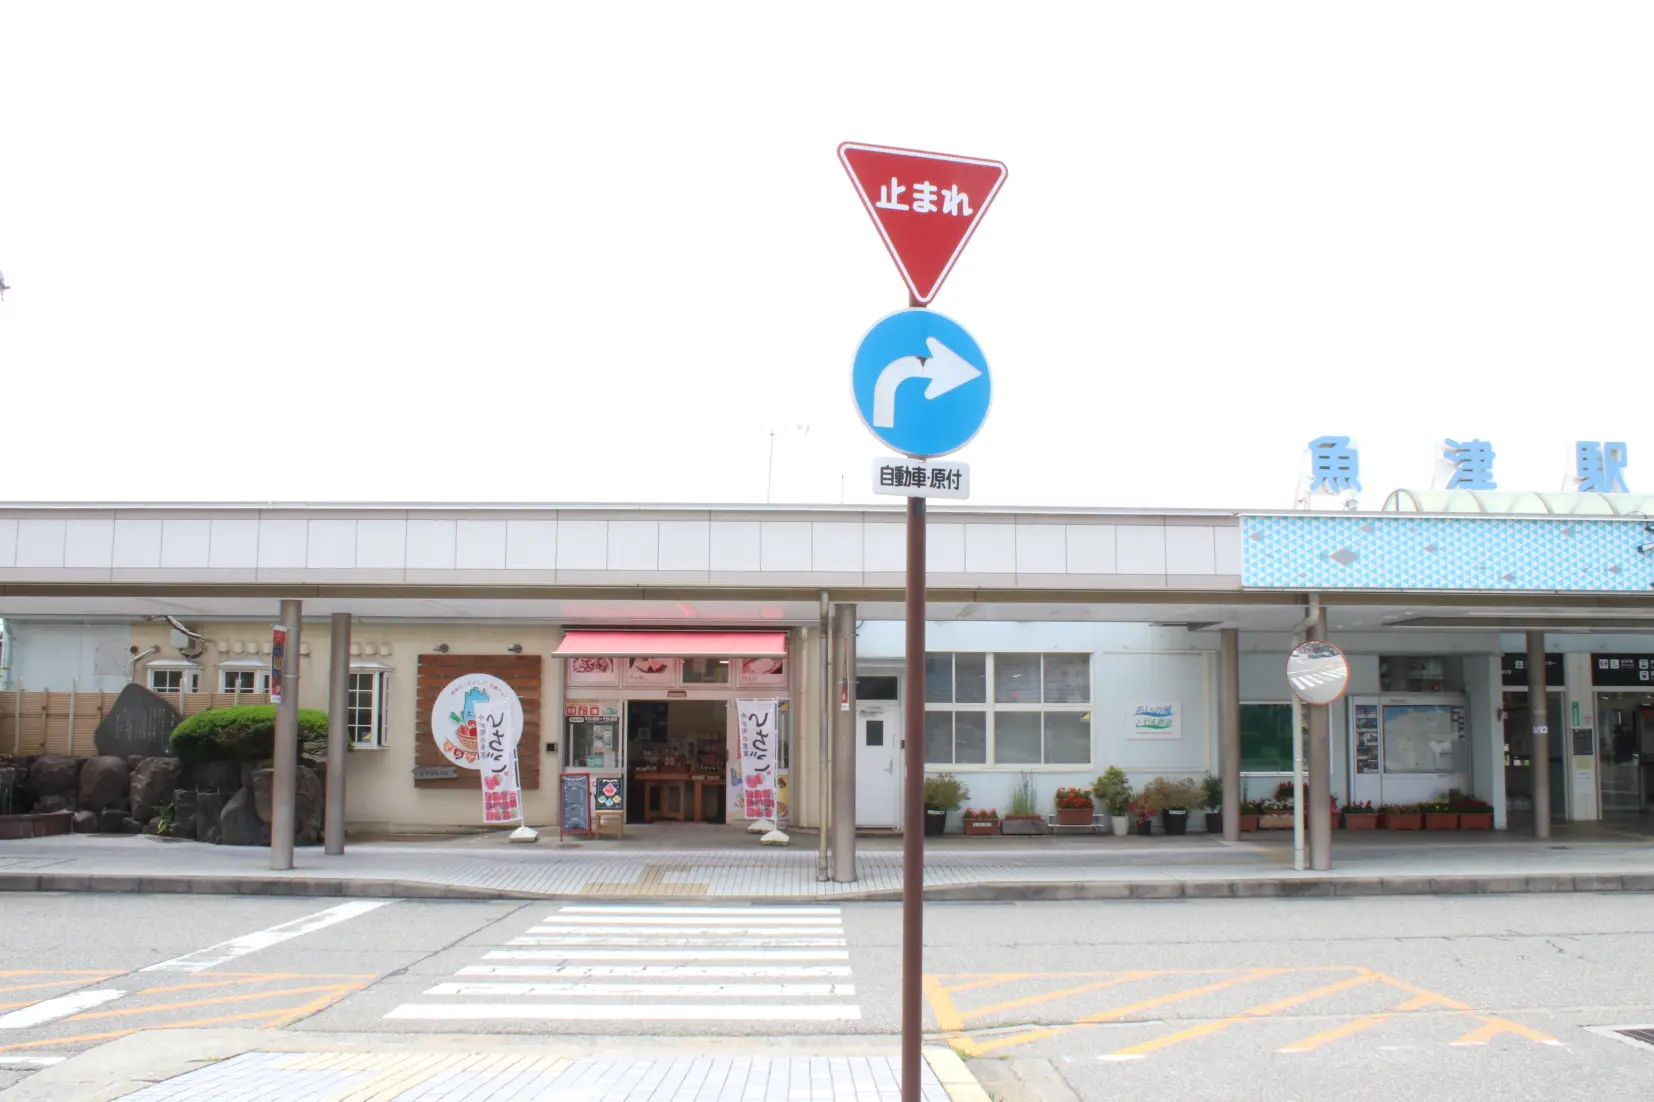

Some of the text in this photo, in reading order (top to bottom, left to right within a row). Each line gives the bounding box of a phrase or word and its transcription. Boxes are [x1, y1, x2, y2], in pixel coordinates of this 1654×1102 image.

[876, 177, 973, 217] 止まれ
[1308, 435, 1630, 493] 魚津駅
